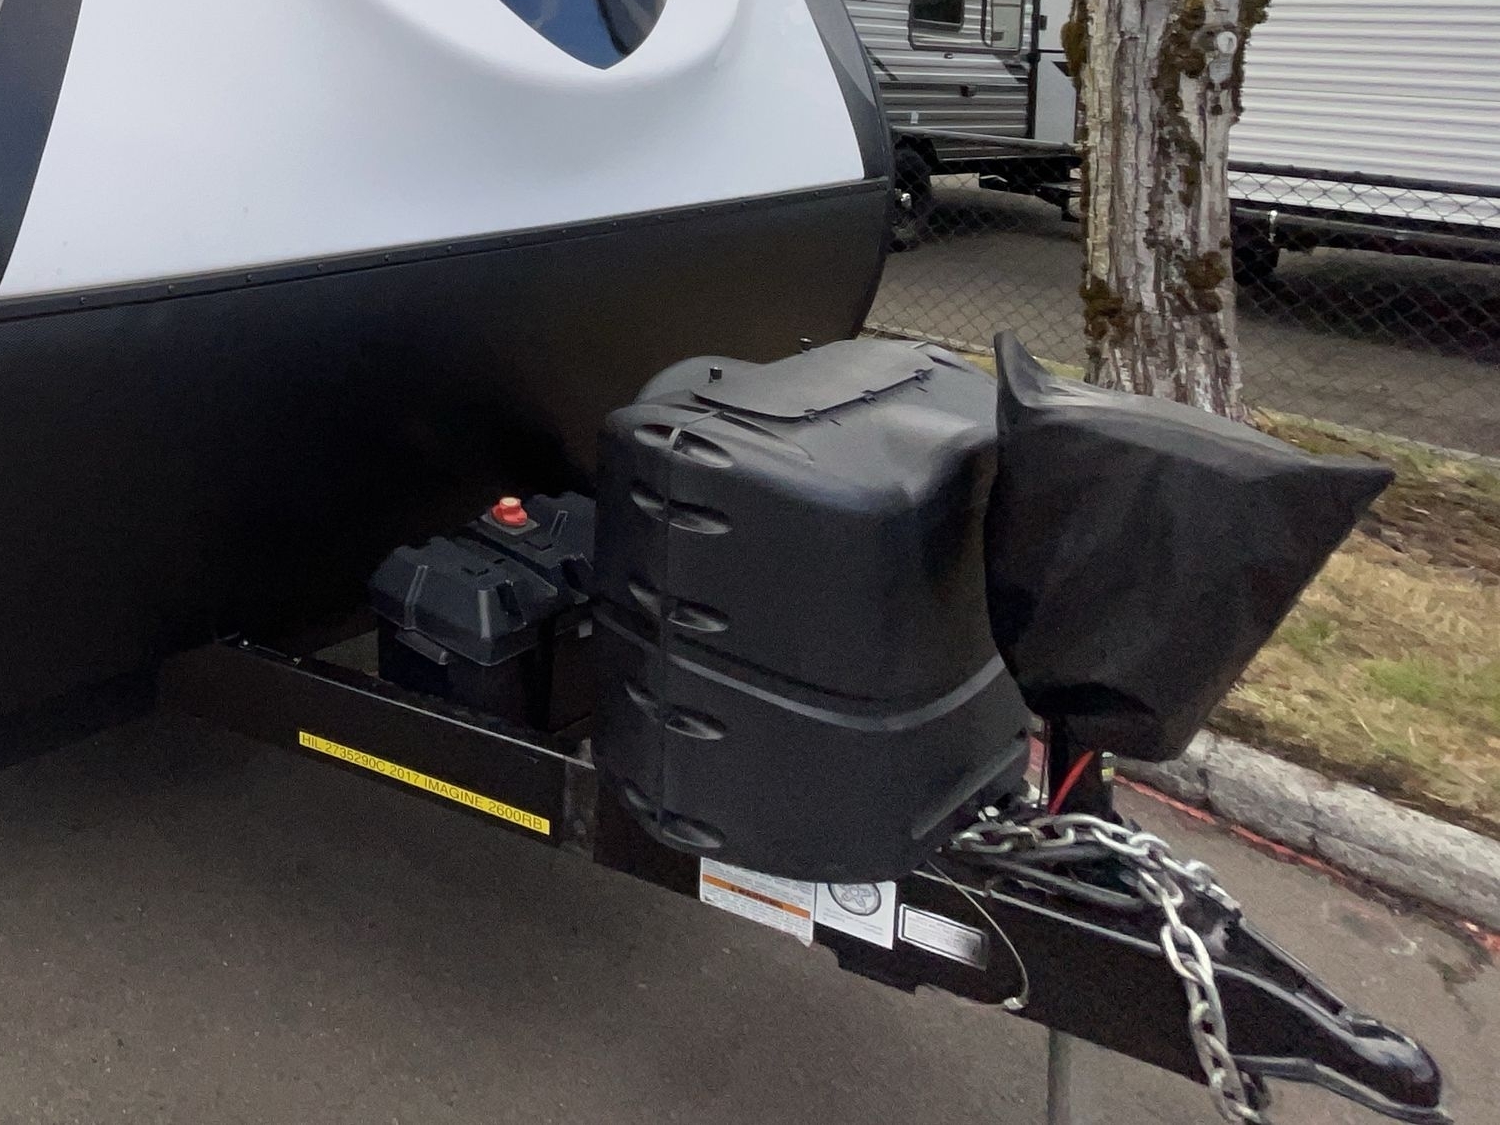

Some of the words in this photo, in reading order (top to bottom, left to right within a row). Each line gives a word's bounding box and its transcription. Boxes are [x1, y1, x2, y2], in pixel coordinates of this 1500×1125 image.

[301, 733, 322, 750] HIL
[324, 741, 386, 773] 2735290C
[389, 764, 421, 785] 2017
[423, 777, 484, 809] IMAGINE
[487, 801, 544, 831] 2600RB
